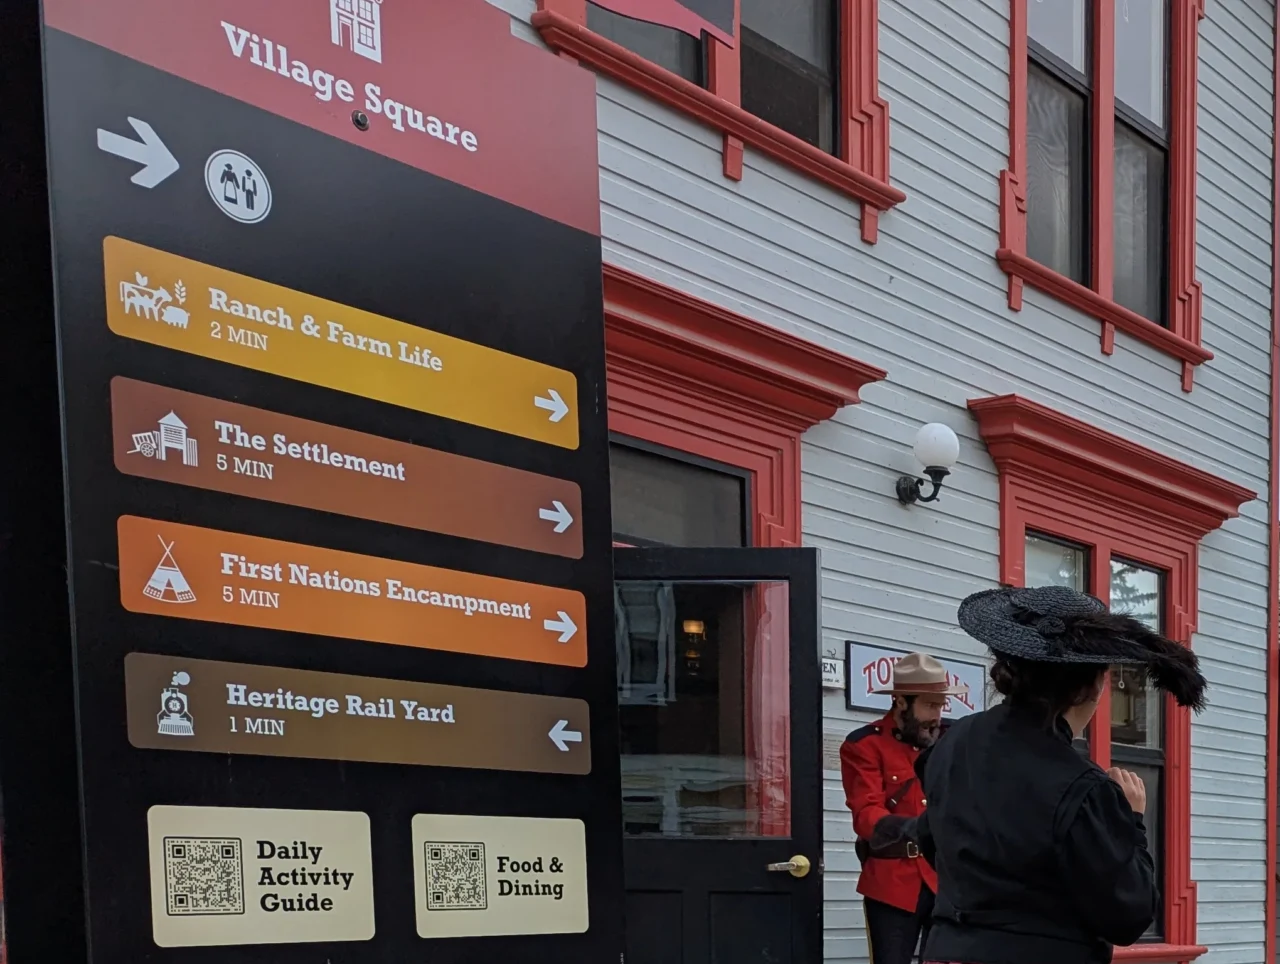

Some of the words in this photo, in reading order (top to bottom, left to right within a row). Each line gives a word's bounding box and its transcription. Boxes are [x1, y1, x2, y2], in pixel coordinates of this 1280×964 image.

[221, 20, 354, 103] Village
[364, 83, 478, 152] Square
[209, 287, 294, 332] Ranch
[300, 315, 321, 338] &
[327, 323, 393, 359] Farm
[398, 342, 443, 372] Life
[210, 321, 221, 339] 2
[228, 327, 268, 351] MIN
[215, 421, 266, 451] The
[273, 433, 406, 482] Settlement
[217, 454, 227, 472] 5
[233, 457, 273, 480] MIN
[220, 553, 282, 583] First
[288, 564, 380, 597] Nations
[386, 579, 531, 620] Encampment
[222, 586, 233, 604] 5
[239, 588, 280, 608] MIN
[823, 662, 837, 674] EN
[226, 684, 339, 718] Heritage
[345, 696, 395, 719] Rail
[400, 701, 455, 724] Yard
[230, 716, 237, 733] 1
[245, 718, 285, 736] MIN
[256, 840, 323, 866] Daily
[497, 856, 544, 874] Food
[550, 856, 564, 874] &
[257, 867, 354, 891] Activity
[498, 879, 564, 901] Dining
[260, 893, 334, 913] Guide
